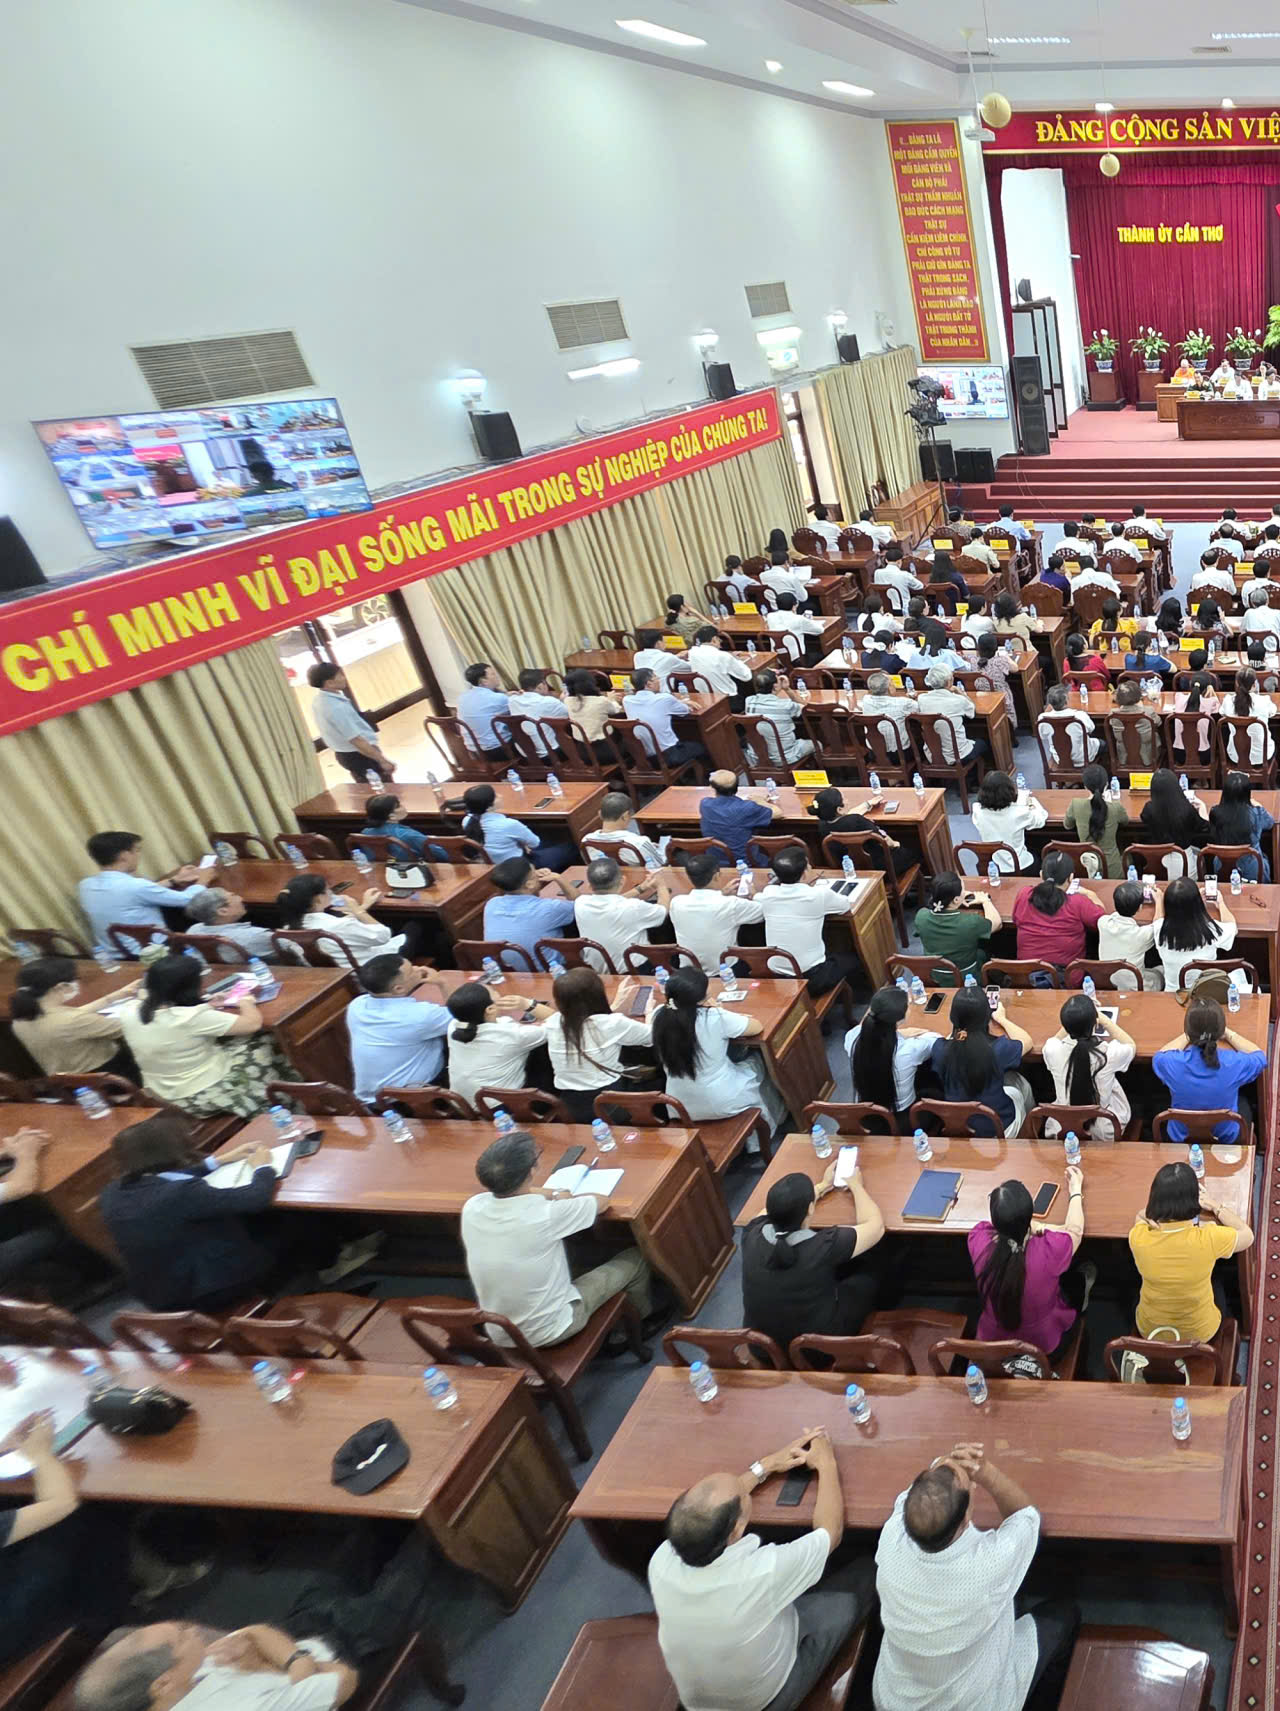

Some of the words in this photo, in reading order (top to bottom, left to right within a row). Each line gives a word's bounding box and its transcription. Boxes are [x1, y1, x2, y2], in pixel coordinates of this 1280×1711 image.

[1036, 114, 1104, 142] ĐẢNG
[1110, 114, 1179, 145] CỘNG
[1185, 111, 1232, 140] SẢN
[1117, 224, 1155, 242] THÀNH
[1158, 222, 1172, 243] ỦY
[1175, 222, 1199, 243] CẦN
[1201, 224, 1224, 242] THƠ
[2, 611, 112, 692] CHÍ
[108, 582, 241, 657] MINH
[238, 554, 290, 612] VĨ
[287, 544, 358, 597] ĐẠI
[359, 516, 445, 573] SỐNG
[446, 492, 500, 543] MÃI
[497, 473, 576, 524] TRONG
[575, 461, 605, 499] SỰ
[606, 439, 668, 478] NGHIỆP
[670, 425, 702, 462] CỦA
[701, 415, 746, 455] CHÚNG
[745, 407, 768, 439] TA!
